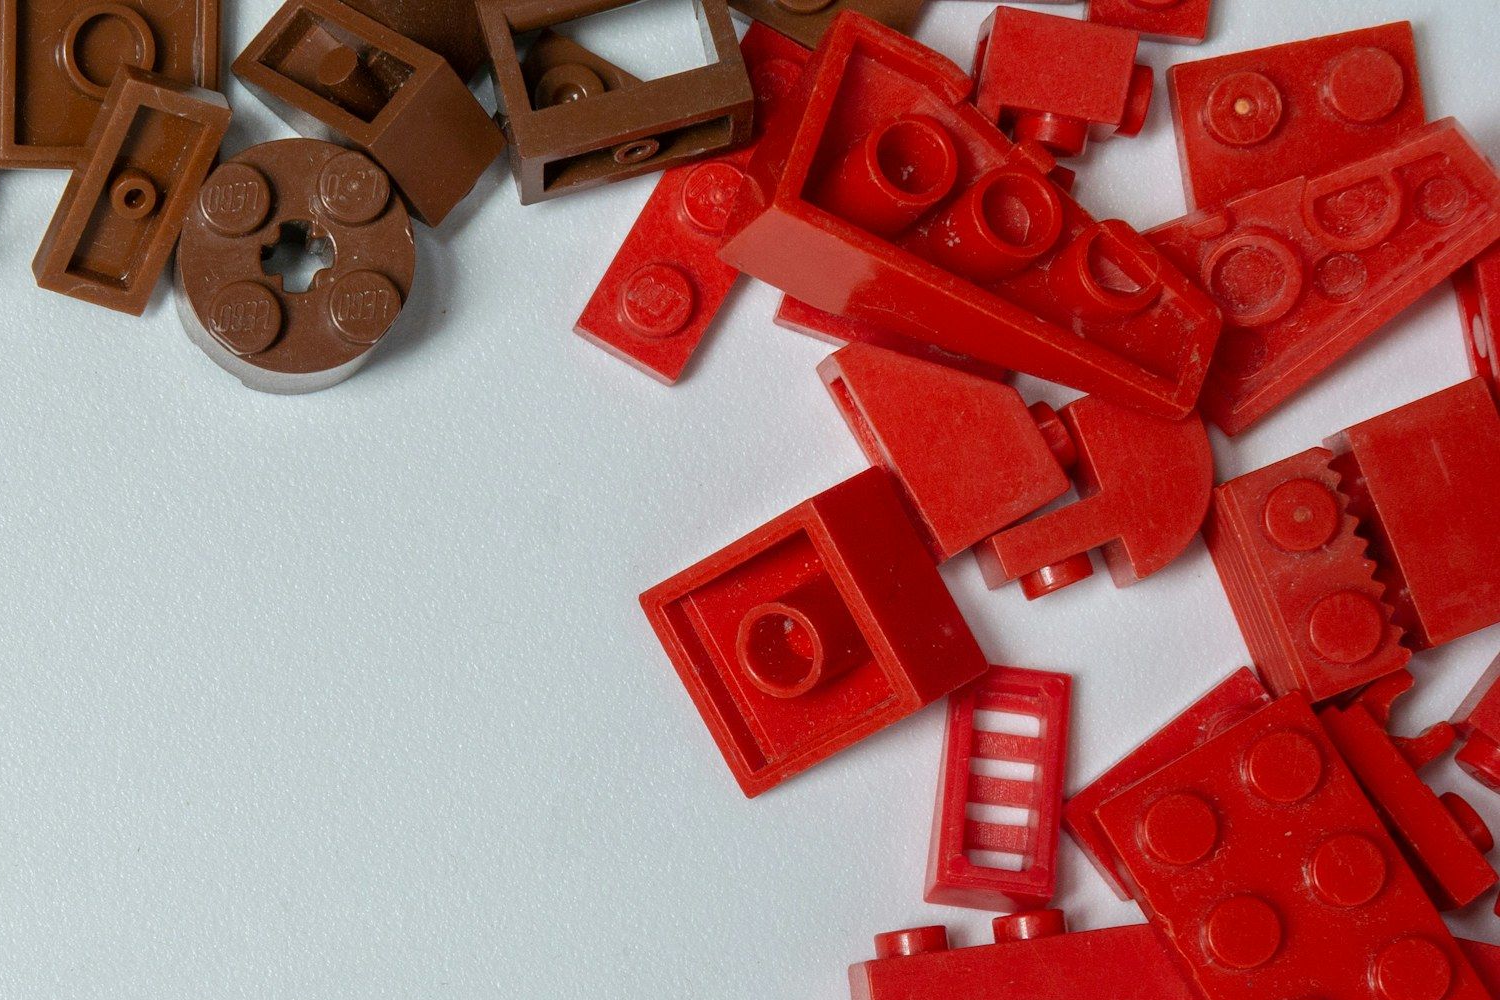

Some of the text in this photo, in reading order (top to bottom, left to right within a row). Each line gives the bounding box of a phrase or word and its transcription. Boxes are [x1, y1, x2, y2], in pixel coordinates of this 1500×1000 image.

[206, 180, 260, 214] LEGO
[215, 299, 271, 333] LEGO
[335, 288, 391, 323] LEGO
